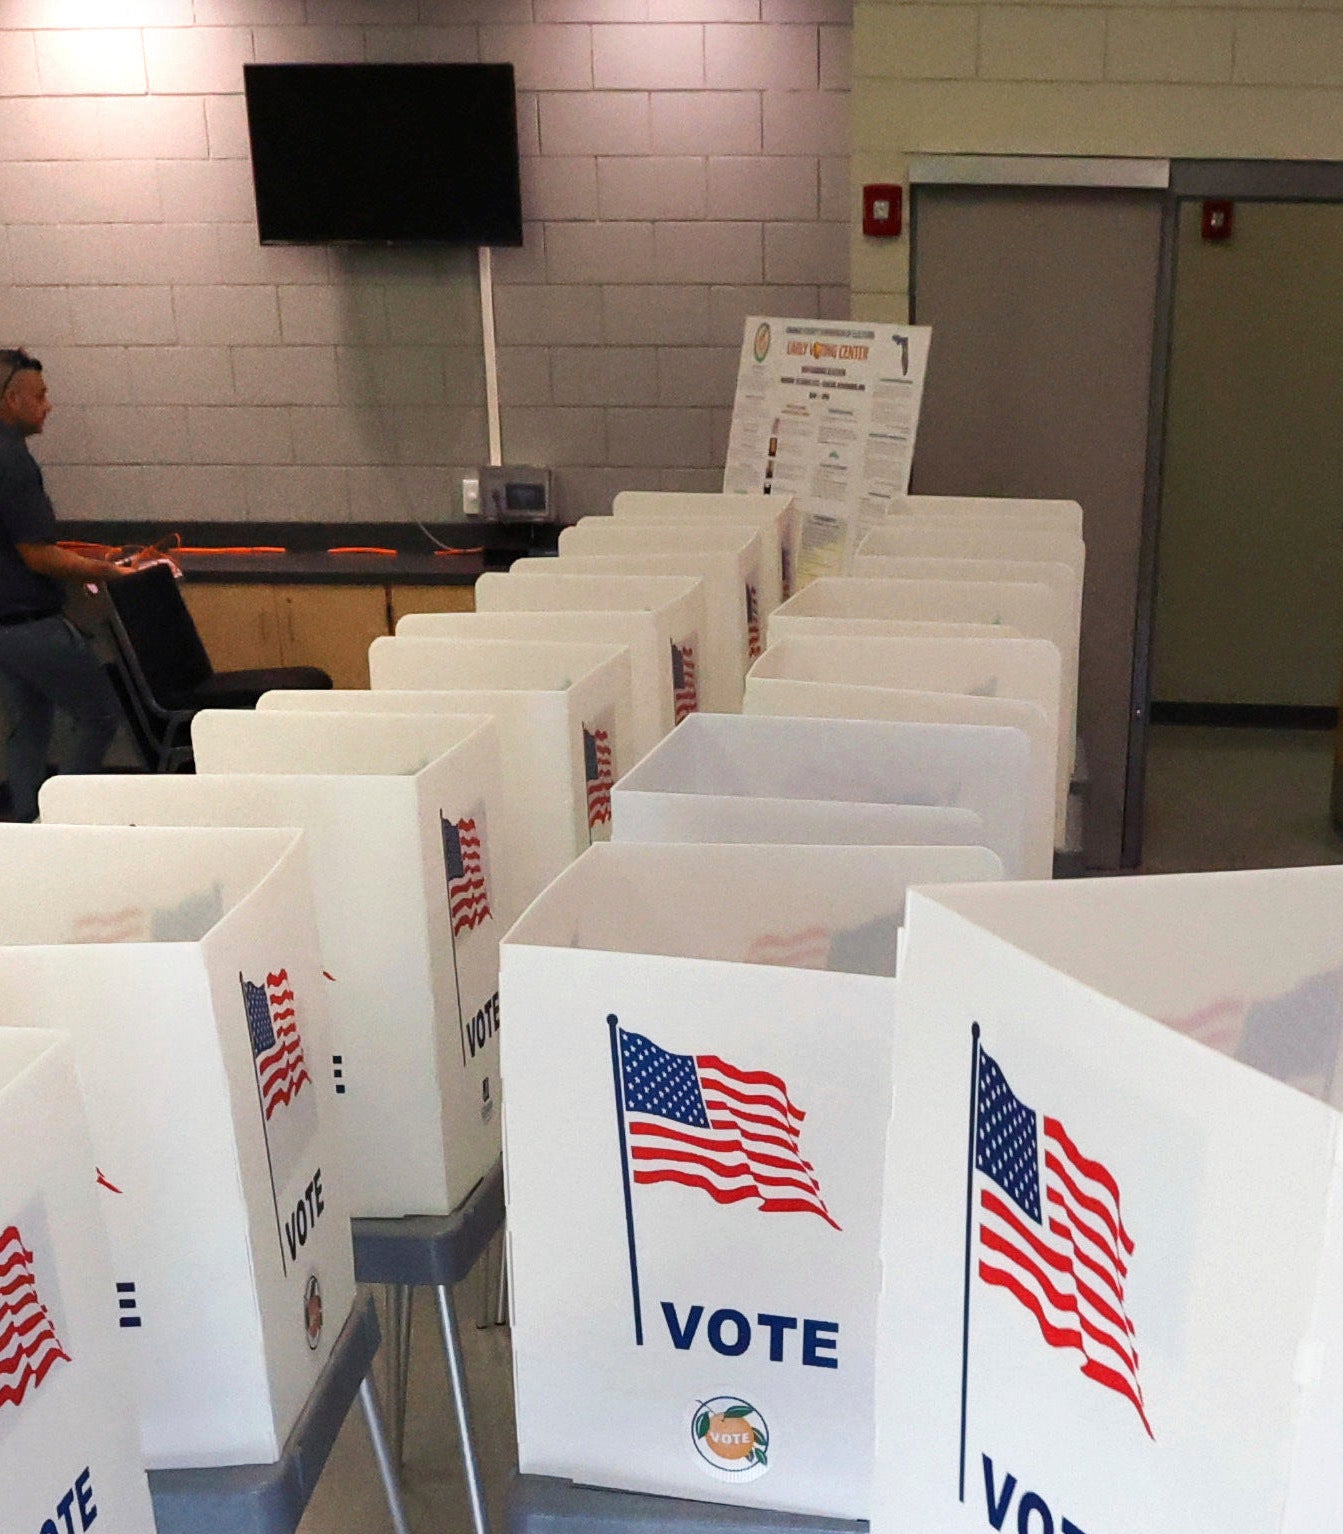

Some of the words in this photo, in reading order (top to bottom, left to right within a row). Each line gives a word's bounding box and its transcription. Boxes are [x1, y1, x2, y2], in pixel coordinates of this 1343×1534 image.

[838, 344, 870, 361] CENTER
[466, 990, 500, 1058] VOTE
[285, 1167, 325, 1262] VOTE
[660, 1301, 840, 1370] VOTE
[709, 1431, 752, 1445] VOTE
